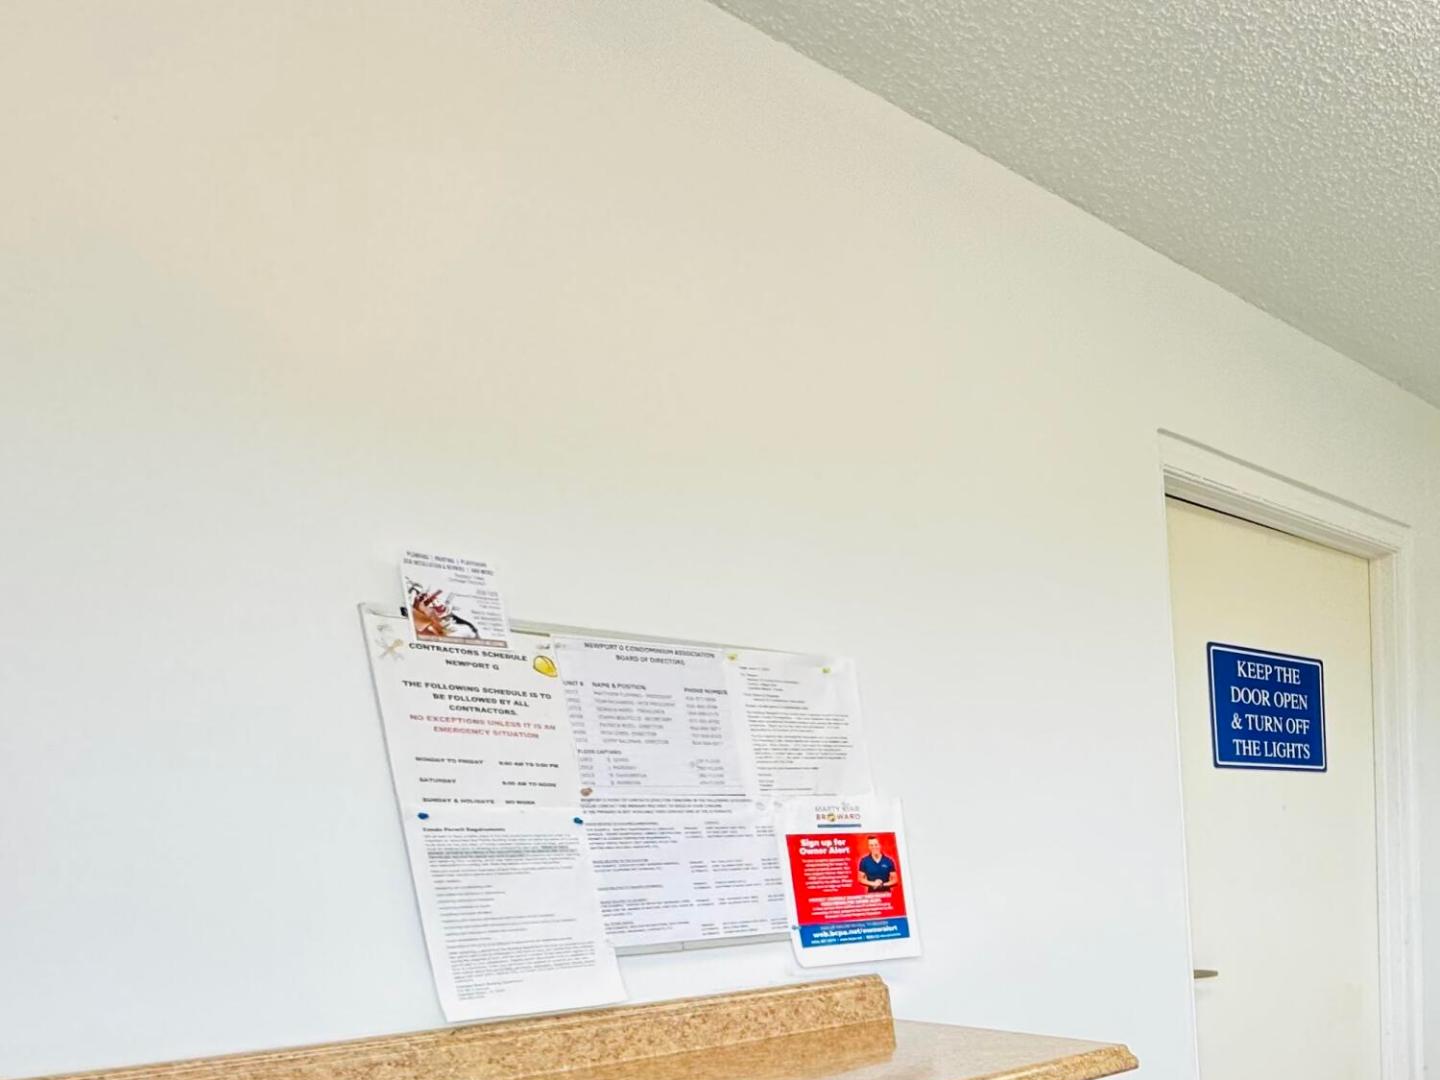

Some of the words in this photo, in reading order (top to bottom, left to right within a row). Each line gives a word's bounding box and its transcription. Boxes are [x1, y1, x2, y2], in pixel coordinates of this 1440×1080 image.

[408, 642, 479, 657] CONTRACTORS
[482, 650, 528, 662] SCHEDULE
[584, 642, 618, 651] NEWPORT
[445, 659, 490, 670] NEWPORT
[615, 654, 639, 663] BOARD
[1237, 660, 1273, 681] KEEP
[1274, 666, 1301, 685] THE
[402, 680, 423, 688] THE
[424, 681, 480, 693] FOLLOWING
[482, 687, 528, 698] SCHEDULE
[529, 691, 538, 699] IS
[432, 693, 446, 701] BE
[447, 694, 497, 705] FOLLOWED
[499, 698, 511, 706] BY
[513, 699, 530, 707] ALL
[1230, 685, 1271, 707] DOOR
[1273, 691, 1308, 710] OPEN
[426, 715, 486, 726] EXCEPTIONS
[487, 719, 522, 728] UNLESS
[1231, 712, 1243, 730] &
[1245, 713, 1283, 733] TURN
[1286, 718, 1310, 735] OFF
[433, 725, 491, 736] EMERGENCY
[493, 729, 539, 739] SITUATION
[1232, 738, 1261, 757] THE
[1264, 741, 1311, 760] LIGHTS
[800, 838, 820, 848] Sign
[820, 841, 832, 849] up
[833, 838, 846, 846] for
[799, 847, 827, 855] Owner
